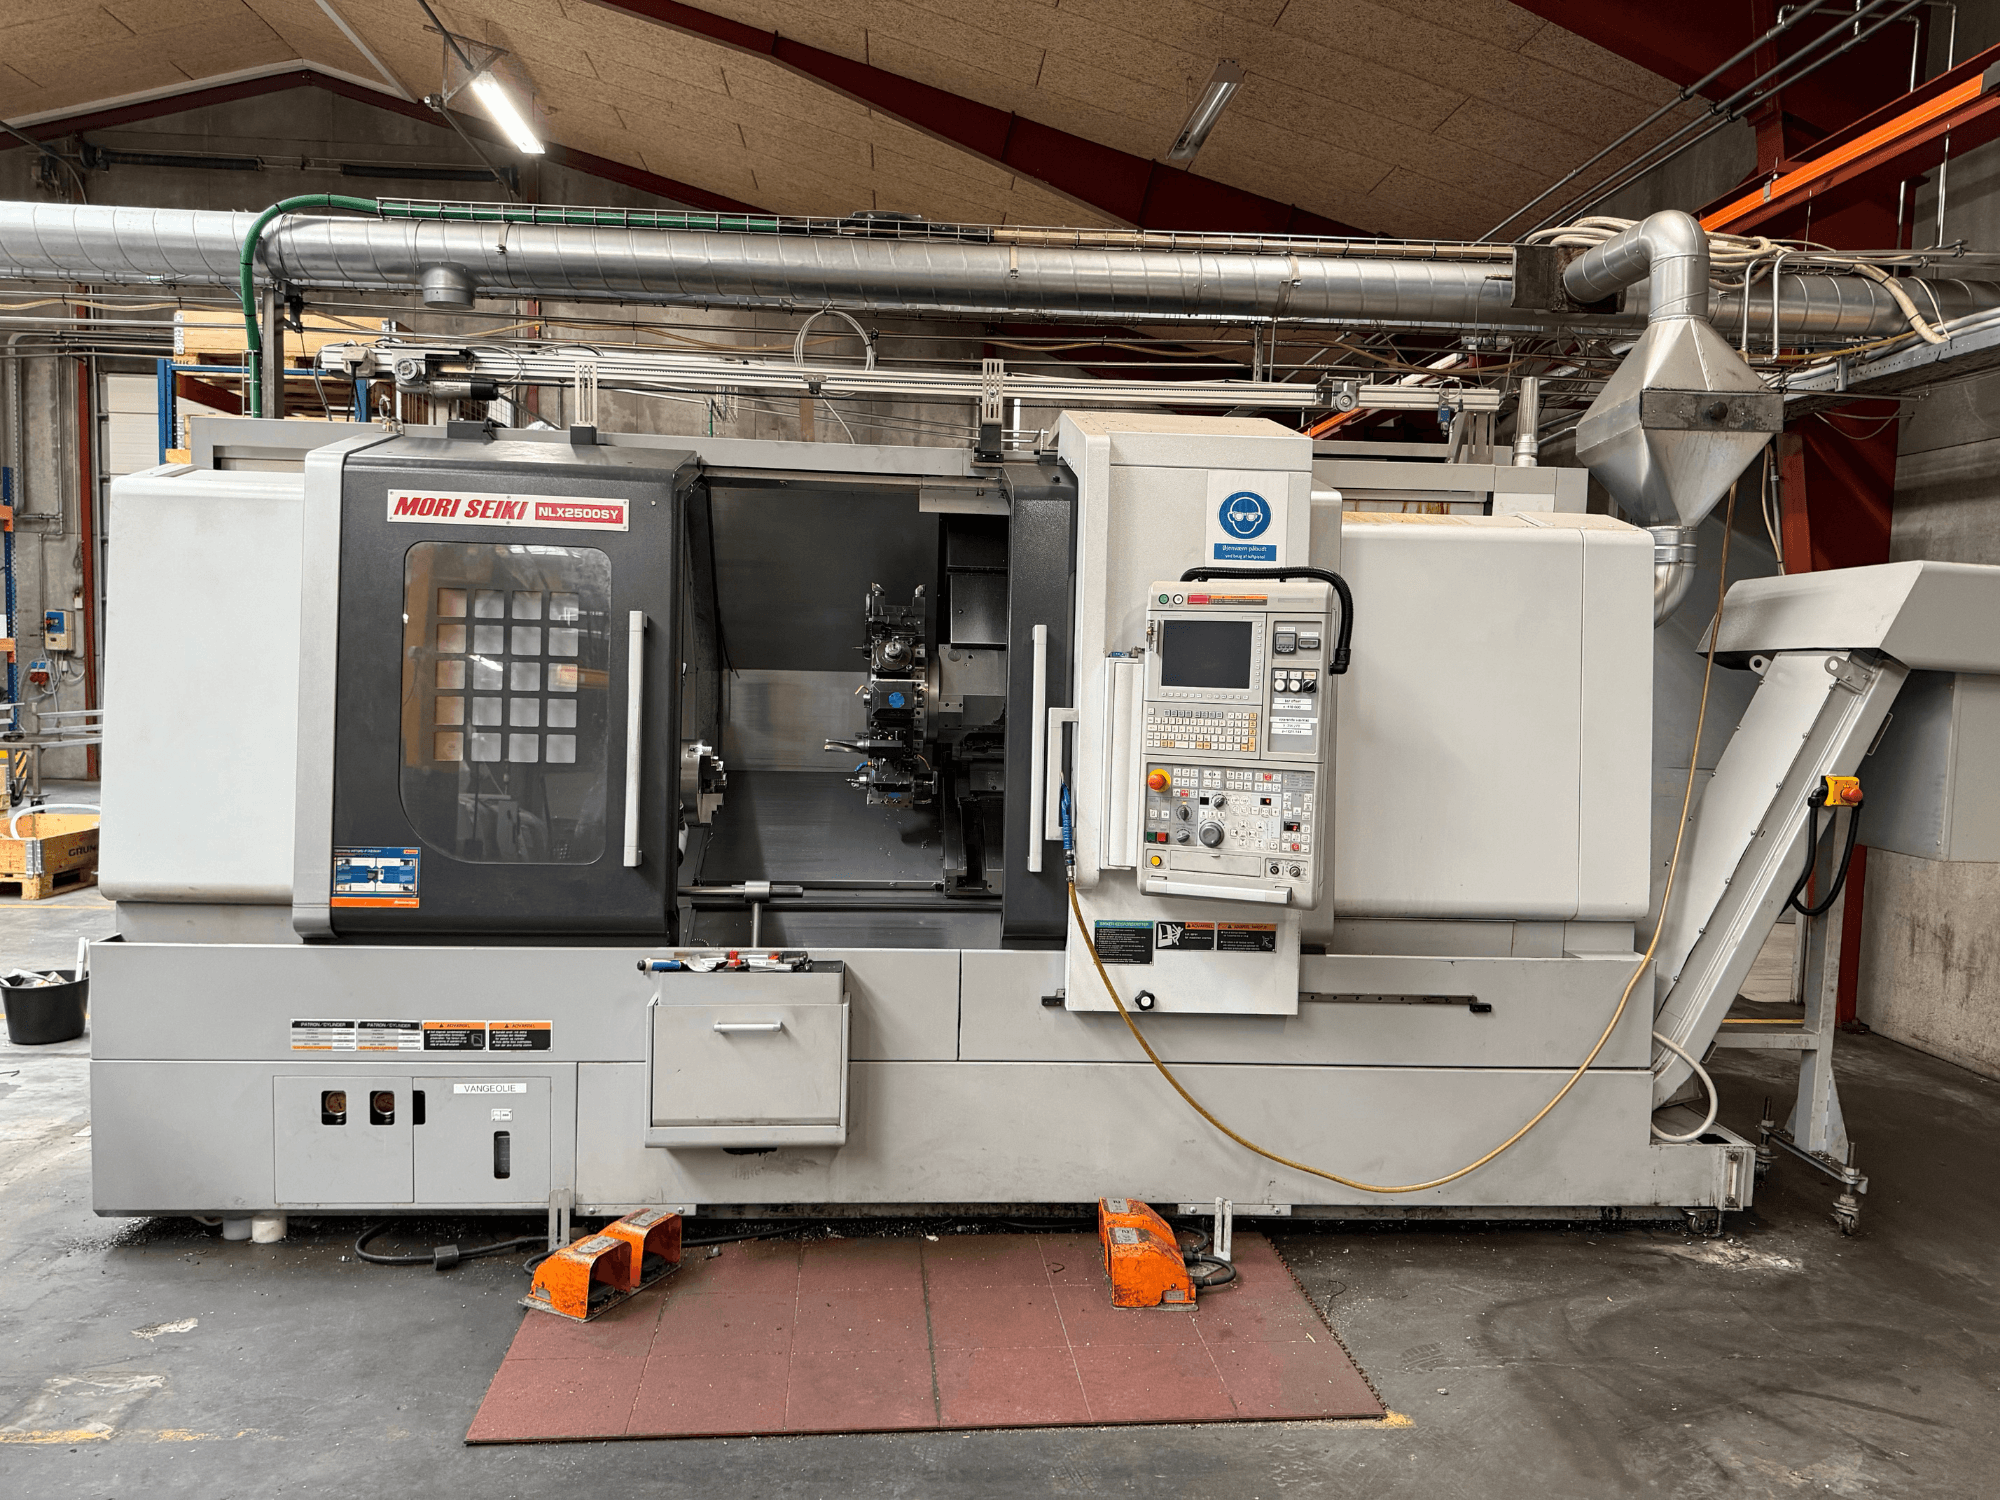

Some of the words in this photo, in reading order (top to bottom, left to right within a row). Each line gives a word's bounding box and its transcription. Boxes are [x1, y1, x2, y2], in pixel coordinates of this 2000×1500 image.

[393, 496, 461, 517] MORI
[464, 499, 529, 520] SEIKI
[538, 506, 619, 520] NLX2500SY
[68, 844, 99, 857] GRUN
[463, 1085, 516, 1093] VANGEOLIE
